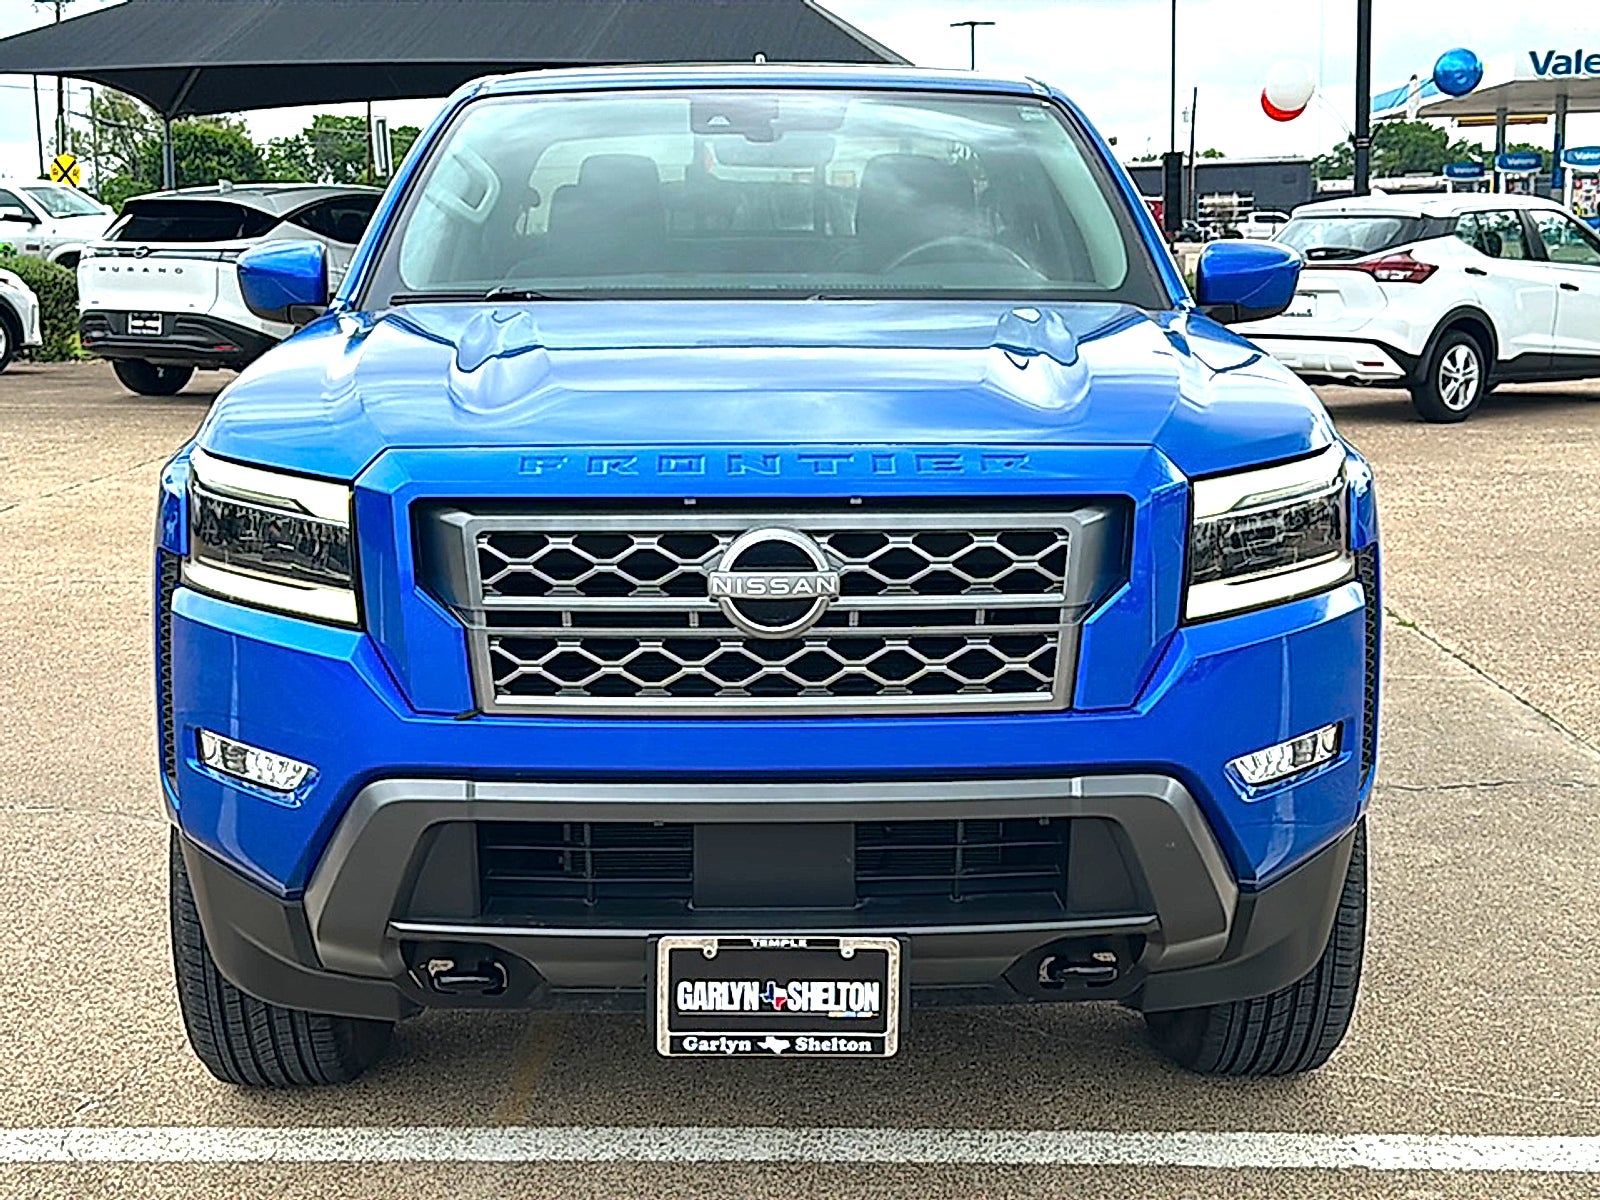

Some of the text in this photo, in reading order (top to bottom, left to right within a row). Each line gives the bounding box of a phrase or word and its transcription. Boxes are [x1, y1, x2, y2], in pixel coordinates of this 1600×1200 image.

[1528, 49, 1600, 75] Vale
[99, 266, 183, 274] MURANO
[518, 453, 1036, 476] FRONTIER
[711, 576, 837, 595] NISSAN
[750, 938, 808, 948] TEMPLE
[677, 981, 880, 1012] GARLYN SHELTON
[682, 1036, 872, 1055] Garlyn Shelton
